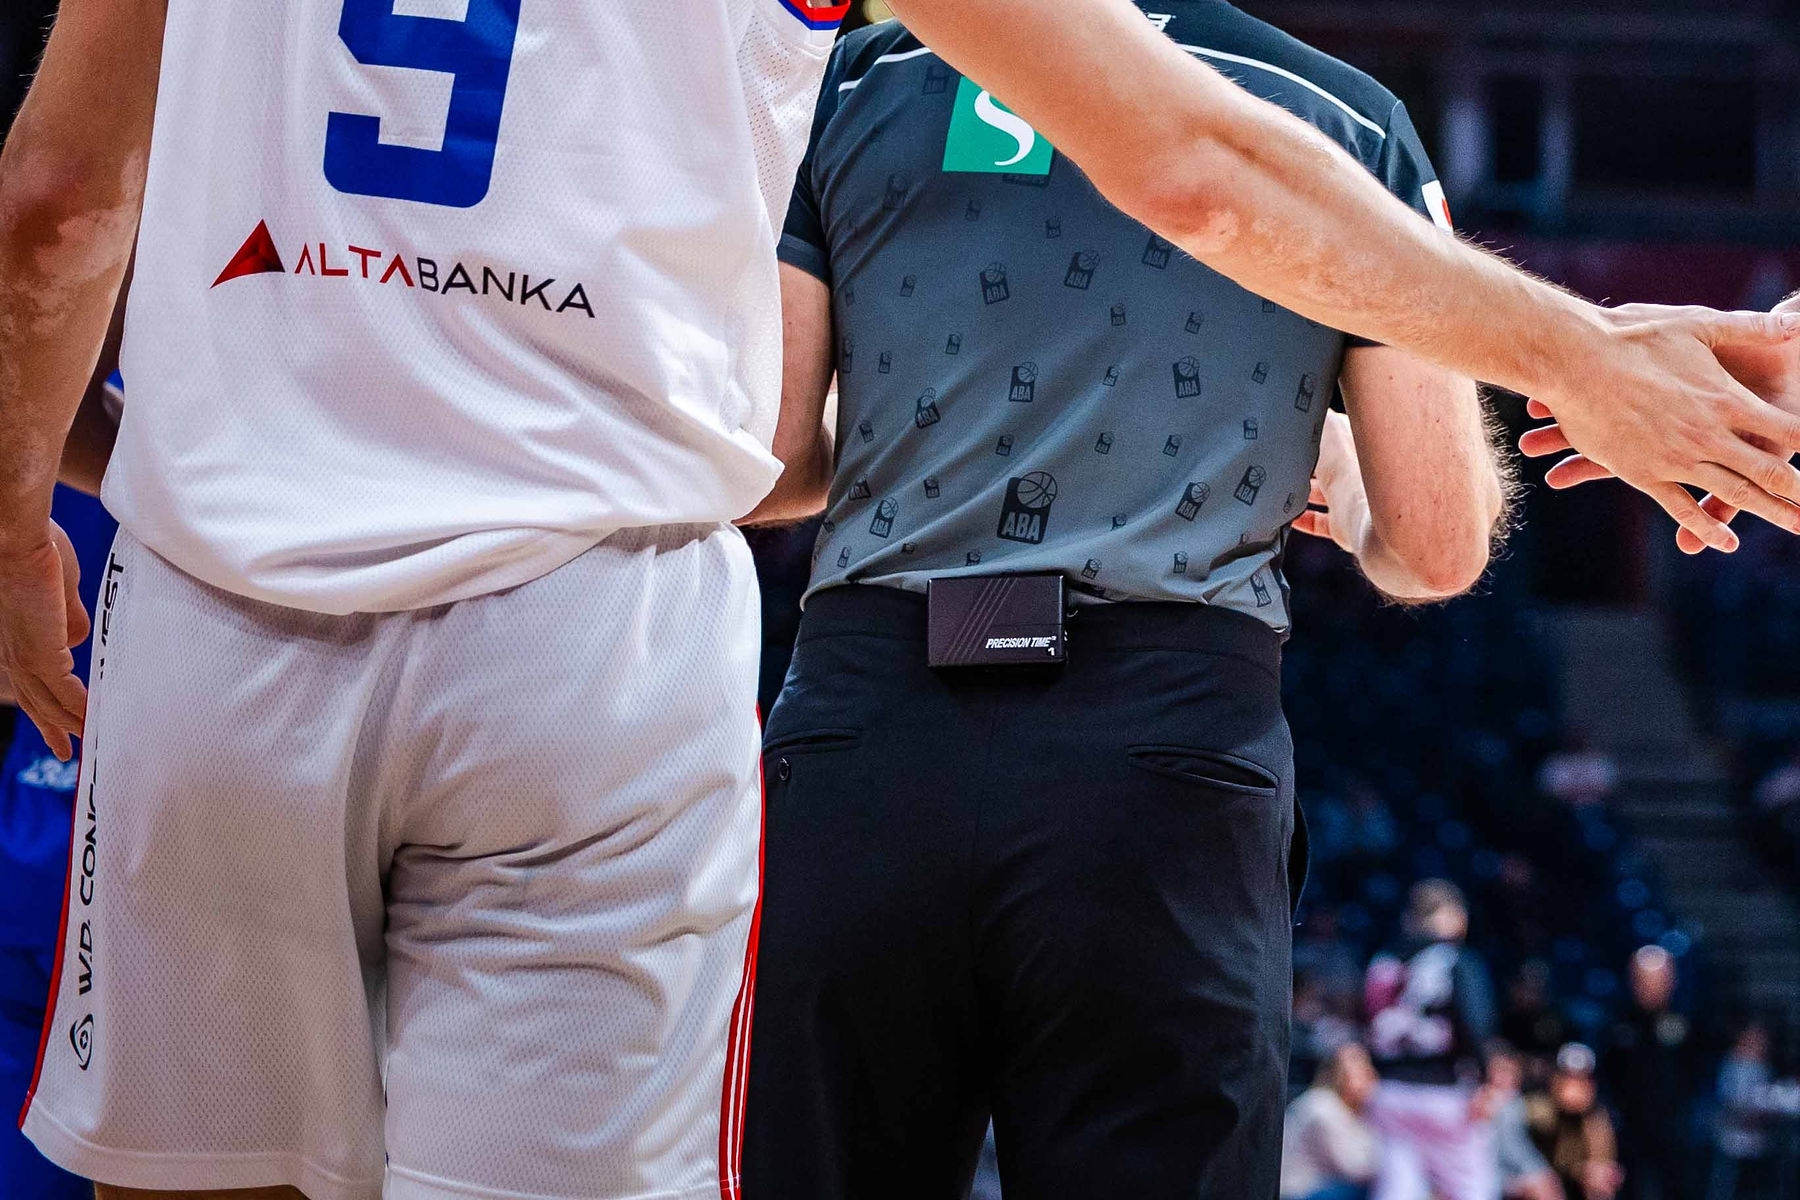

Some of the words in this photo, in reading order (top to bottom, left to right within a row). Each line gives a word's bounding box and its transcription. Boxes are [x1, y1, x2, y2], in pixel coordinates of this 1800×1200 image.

[294, 242, 595, 318] ALTABANKA
[1002, 512, 1041, 541] ABA
[985, 637, 1031, 648] PRECISION
[78, 918, 94, 996] W.D.
[100, 552, 124, 680] EST
